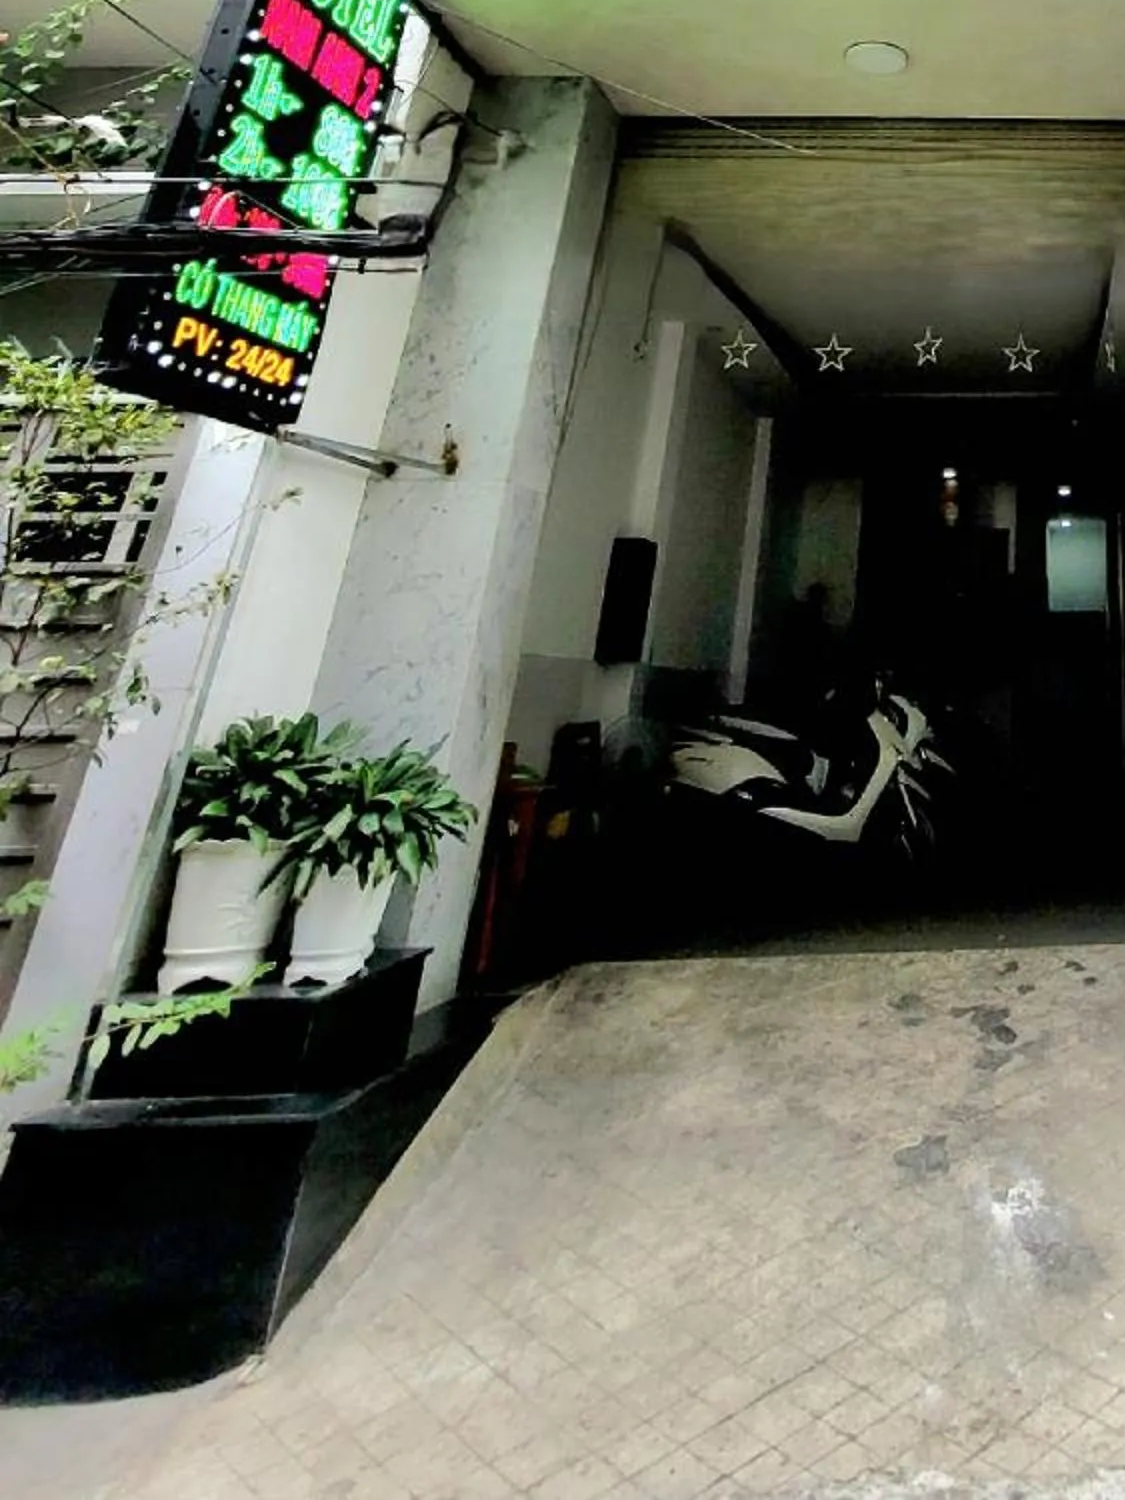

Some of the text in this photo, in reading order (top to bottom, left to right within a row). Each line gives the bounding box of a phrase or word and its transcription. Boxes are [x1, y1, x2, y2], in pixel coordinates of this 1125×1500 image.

[353, 66, 382, 121] 2
[175, 257, 217, 310] CÓ
[211, 272, 281, 341] THANG
[172, 316, 296, 387] PV: 24/24
